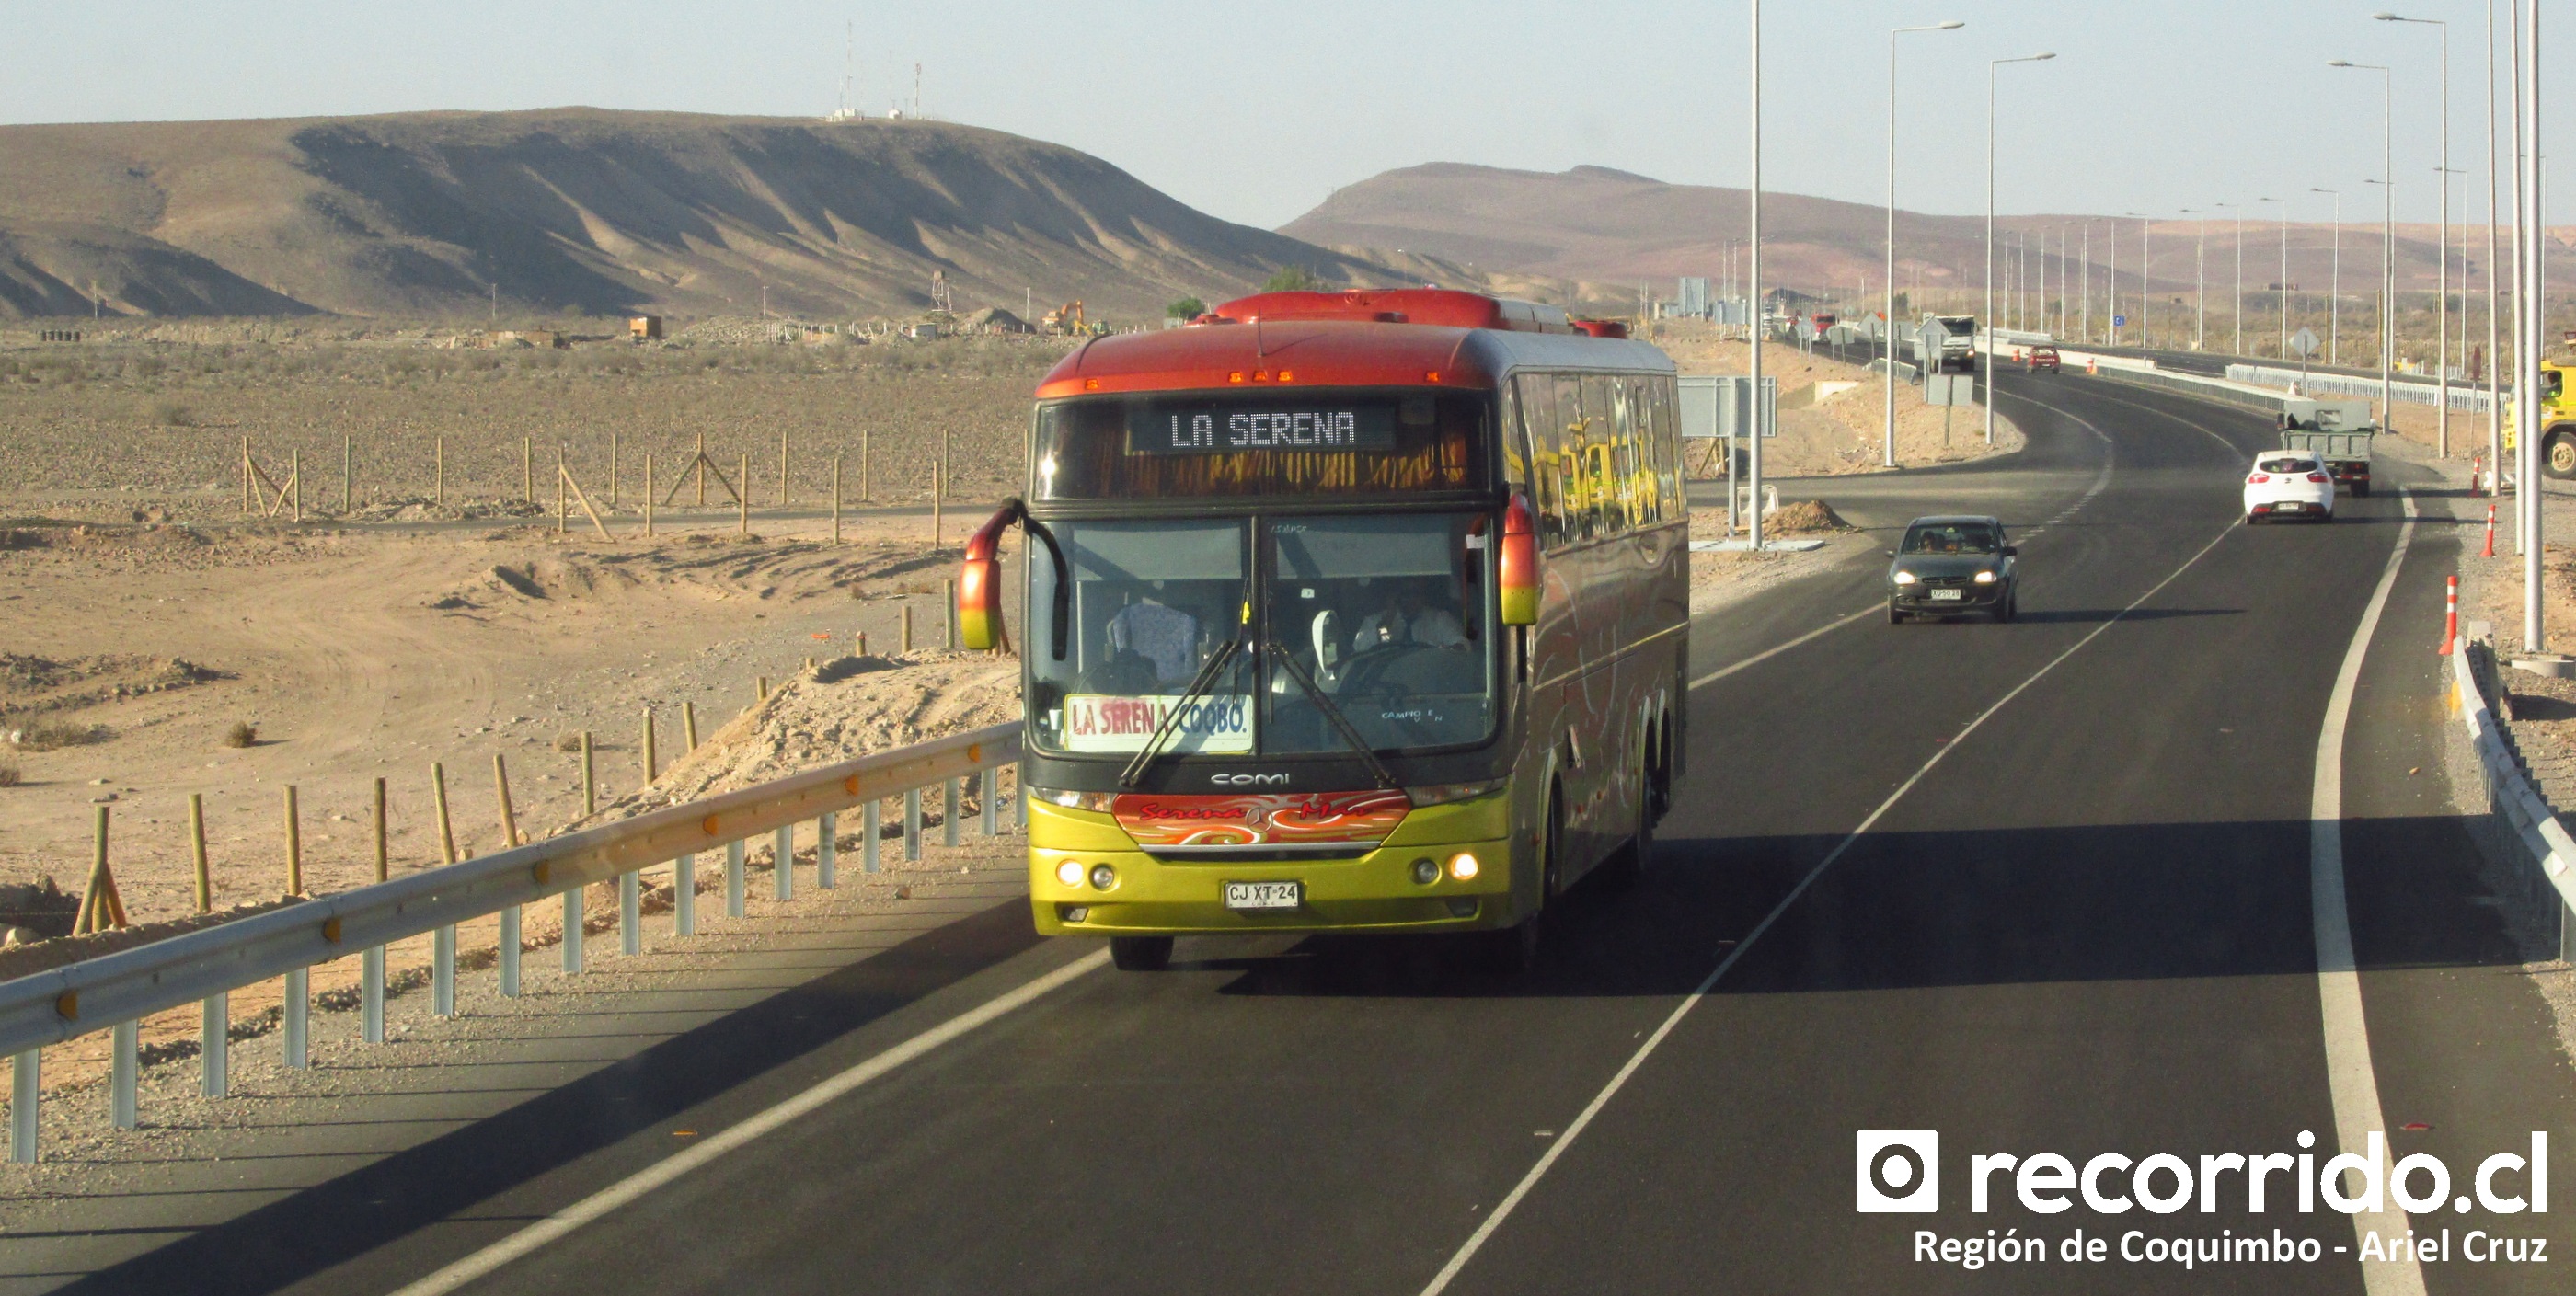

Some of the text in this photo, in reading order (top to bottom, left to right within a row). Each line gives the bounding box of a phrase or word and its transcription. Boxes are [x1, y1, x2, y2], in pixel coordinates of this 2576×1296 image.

[1172, 412, 1355, 446] LA SERENA
[1073, 704, 1097, 735] LA
[1100, 703, 1171, 735] SERENA
[1139, 802, 1247, 820] Serena
